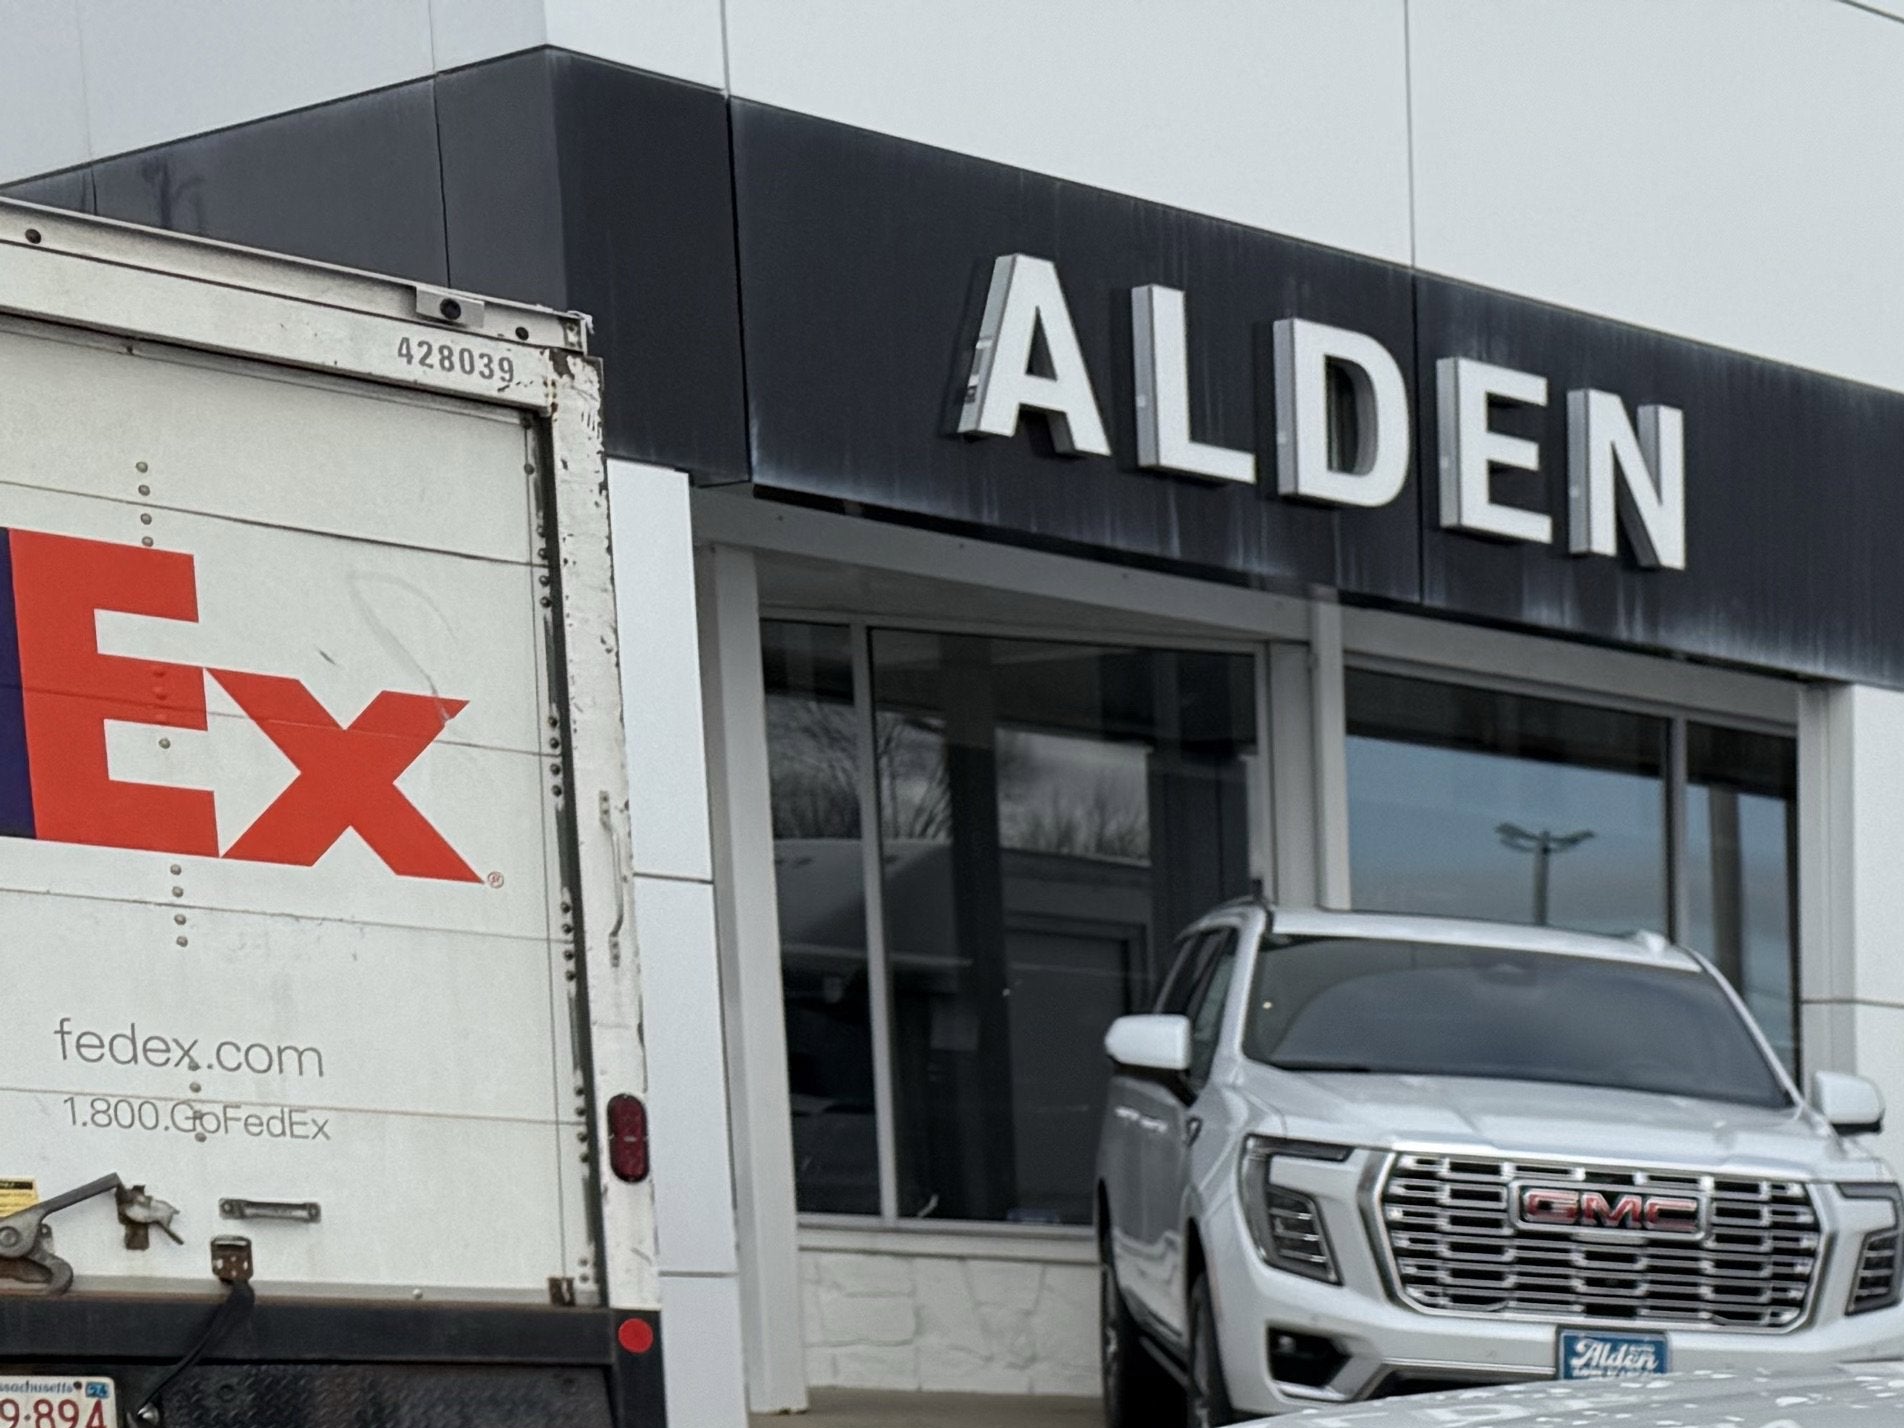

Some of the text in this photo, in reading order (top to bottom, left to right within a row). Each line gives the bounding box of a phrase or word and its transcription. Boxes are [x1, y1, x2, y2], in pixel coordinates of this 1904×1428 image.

[398, 337, 514, 383] 428039
[958, 252, 1687, 570] ALDEN
[0, 527, 485, 884] Ex
[54, 1018, 324, 1077] fedex.com
[64, 1096, 331, 1140] 1.800.GoFedEx
[1523, 1188, 1698, 1233] GMC
[1570, 1338, 1659, 1371] Alden
